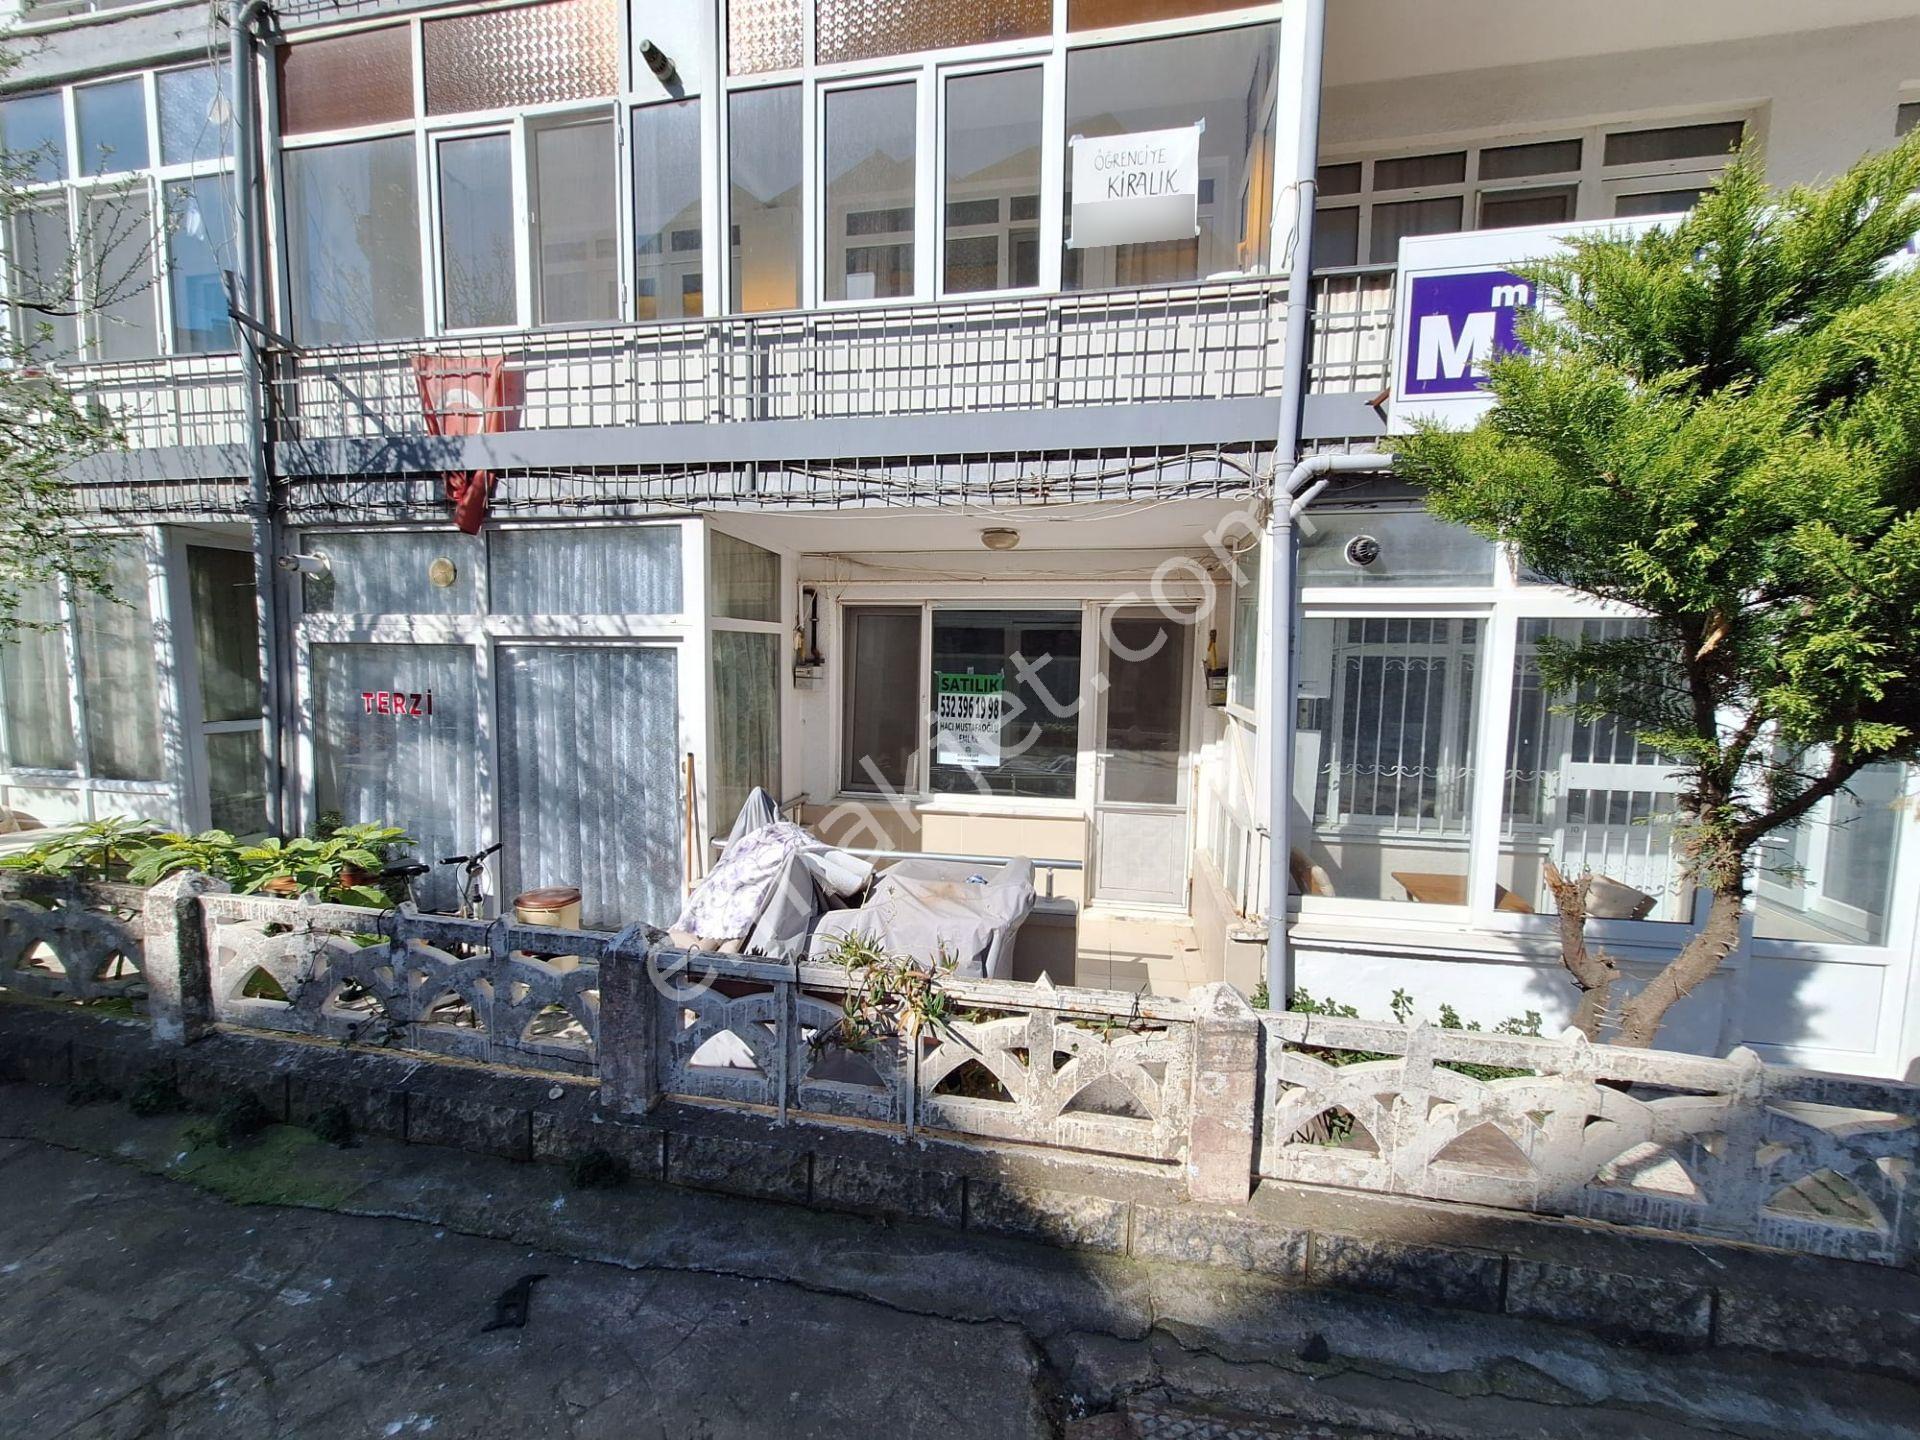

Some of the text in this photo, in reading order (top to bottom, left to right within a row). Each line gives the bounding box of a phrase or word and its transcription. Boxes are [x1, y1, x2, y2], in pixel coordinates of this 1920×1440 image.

[1108, 169, 1180, 199] KİRALIK
[941, 677, 999, 693] SATILIK
[361, 688, 433, 715] TERZİ
[940, 695, 999, 720] 532 396 19 98
[958, 733, 978, 744] EMLK
